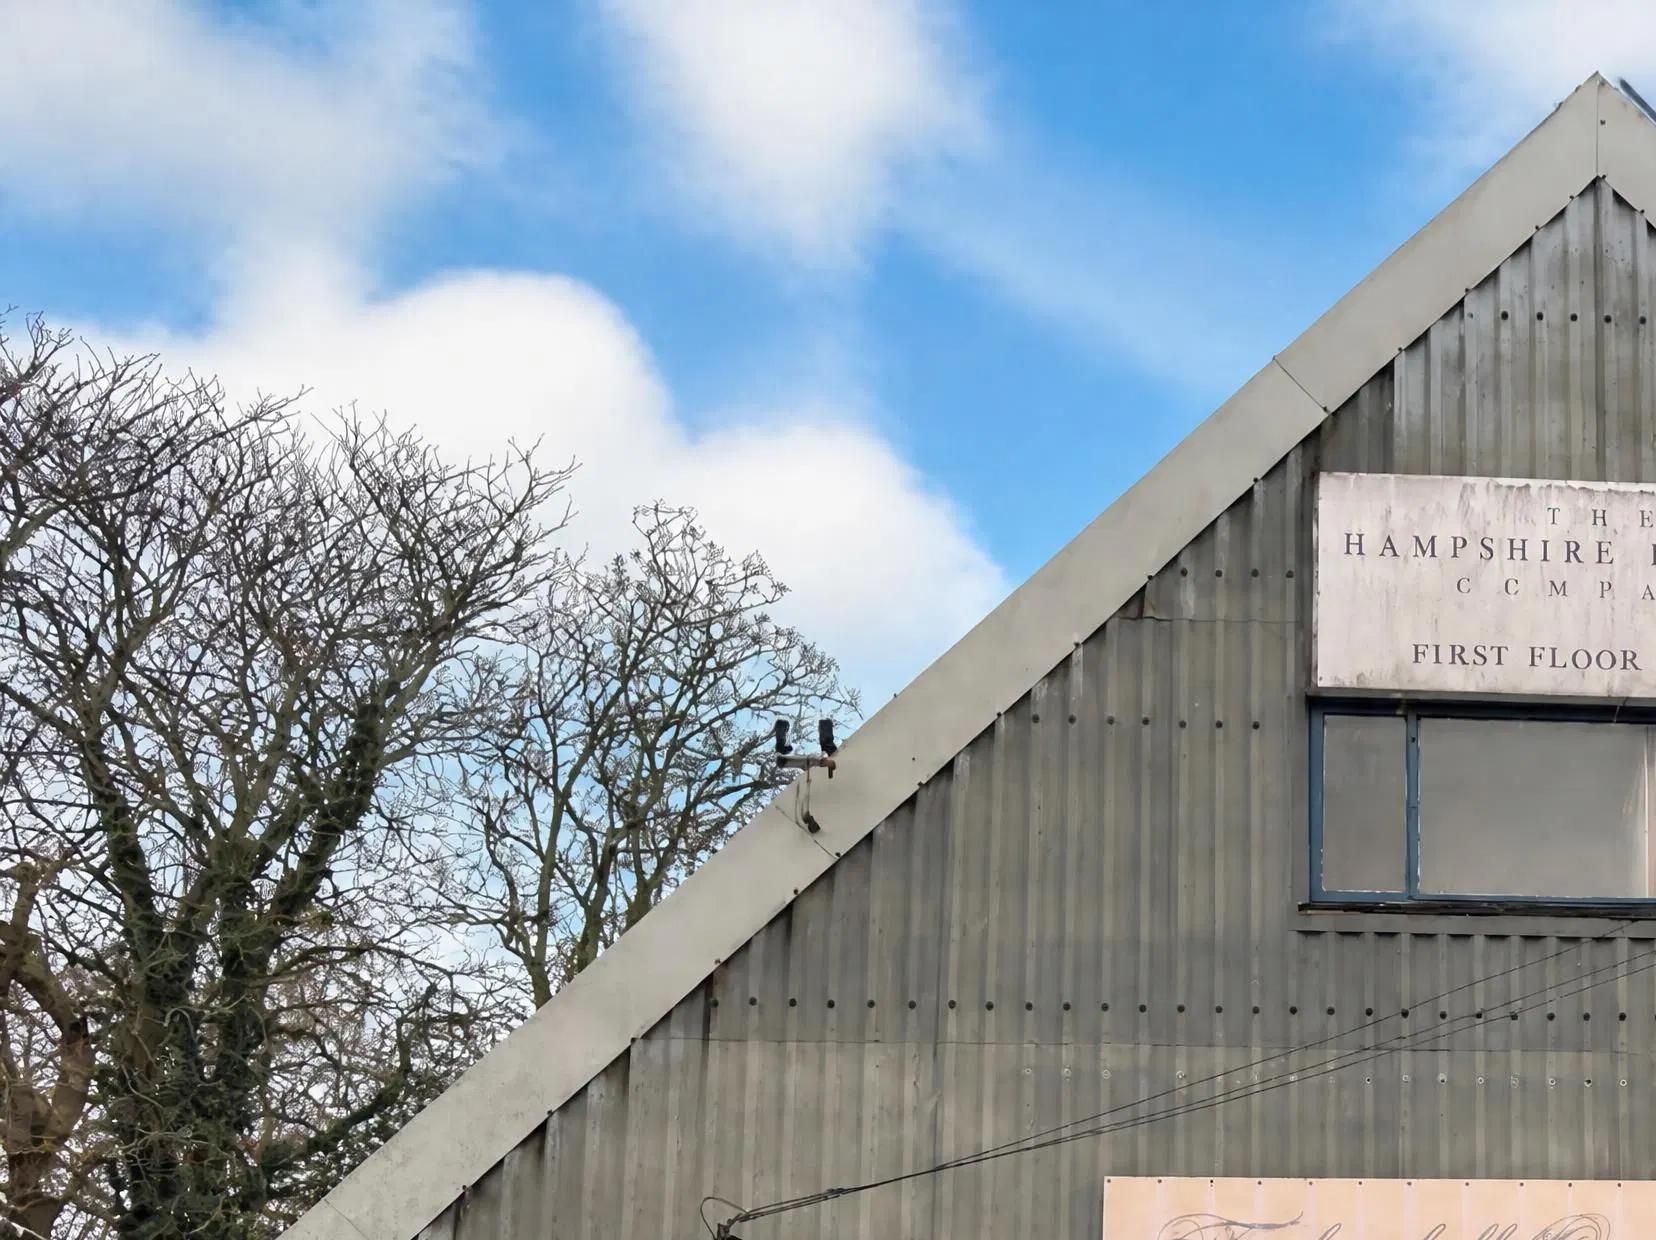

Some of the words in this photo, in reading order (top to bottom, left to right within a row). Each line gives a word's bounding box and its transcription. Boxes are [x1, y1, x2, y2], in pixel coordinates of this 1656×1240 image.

[1547, 507, 1654, 529] THE
[1344, 531, 1615, 566] HAMPSHIRE
[1412, 643, 1509, 667] FIRST
[1528, 645, 1642, 671] FLOOR
